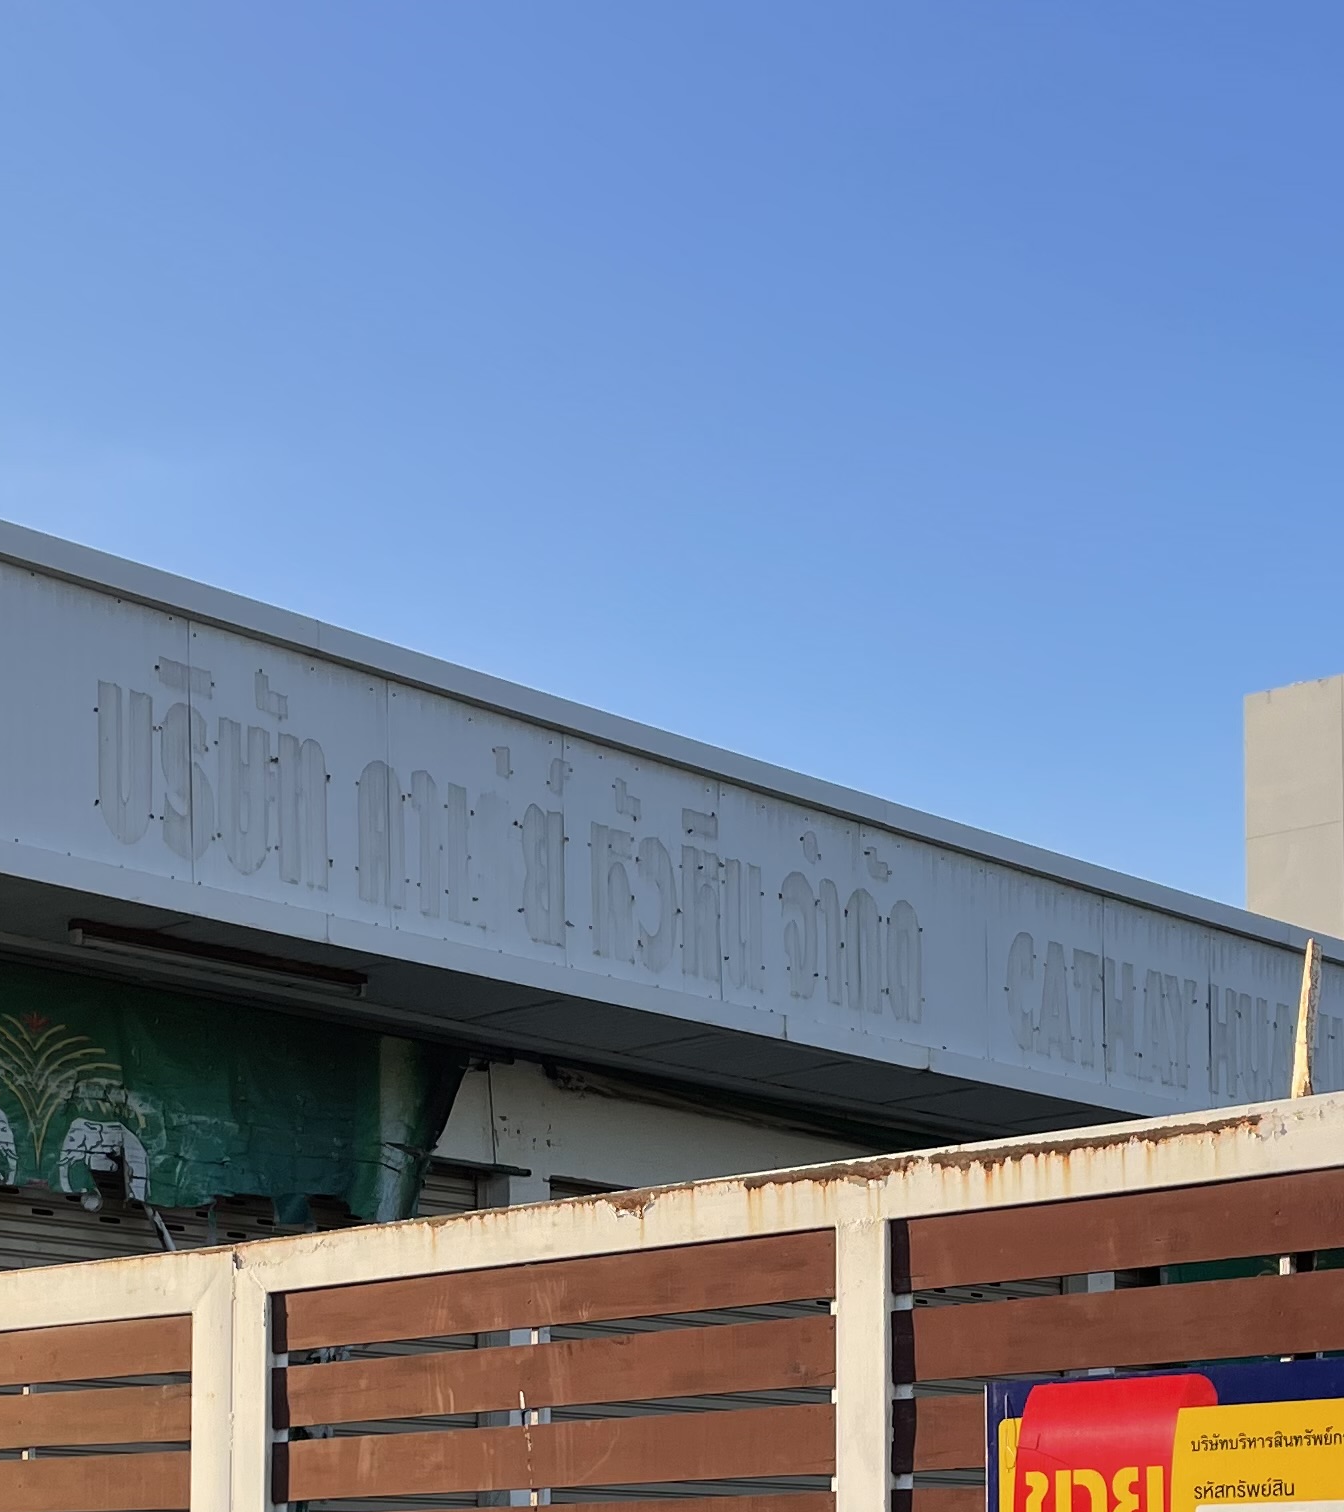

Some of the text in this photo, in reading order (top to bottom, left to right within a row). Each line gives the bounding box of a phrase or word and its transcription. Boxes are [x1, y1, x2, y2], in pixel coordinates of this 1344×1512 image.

[1193, 1477, 1295, 1499] รหัสทรัพย์สิน
